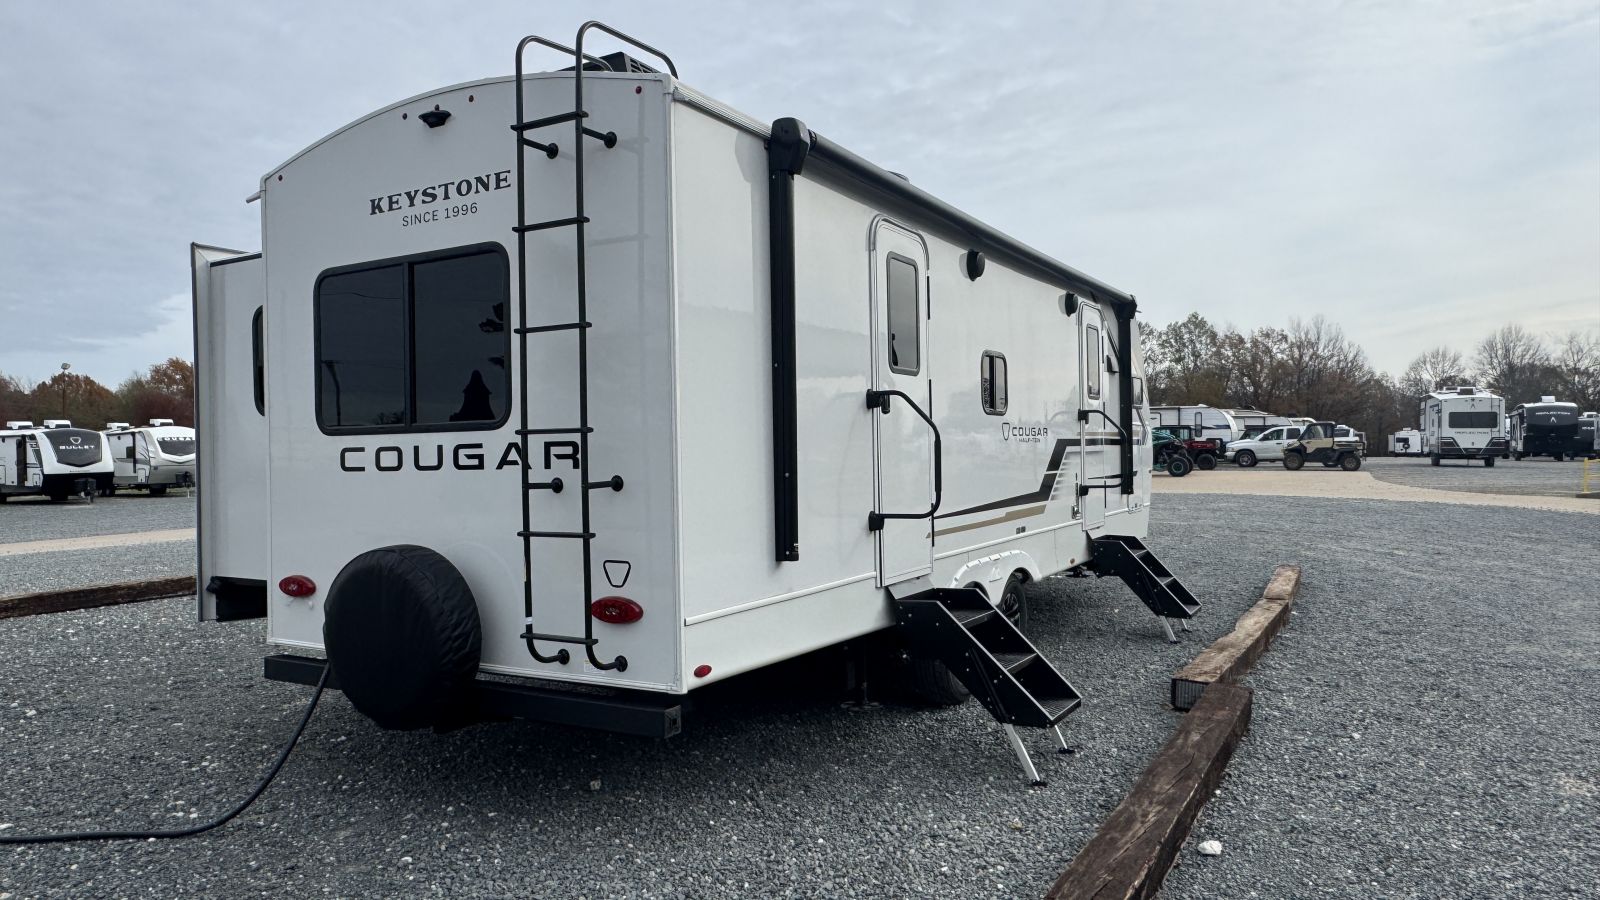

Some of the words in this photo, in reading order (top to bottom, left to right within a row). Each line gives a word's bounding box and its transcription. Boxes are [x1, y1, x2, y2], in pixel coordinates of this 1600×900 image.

[369, 169, 512, 216] KEYSTONE
[402, 209, 439, 227] SINCE
[444, 202, 478, 220] 1996
[1011, 426, 1048, 437] COUGAR
[340, 440, 581, 472] COUGAR
